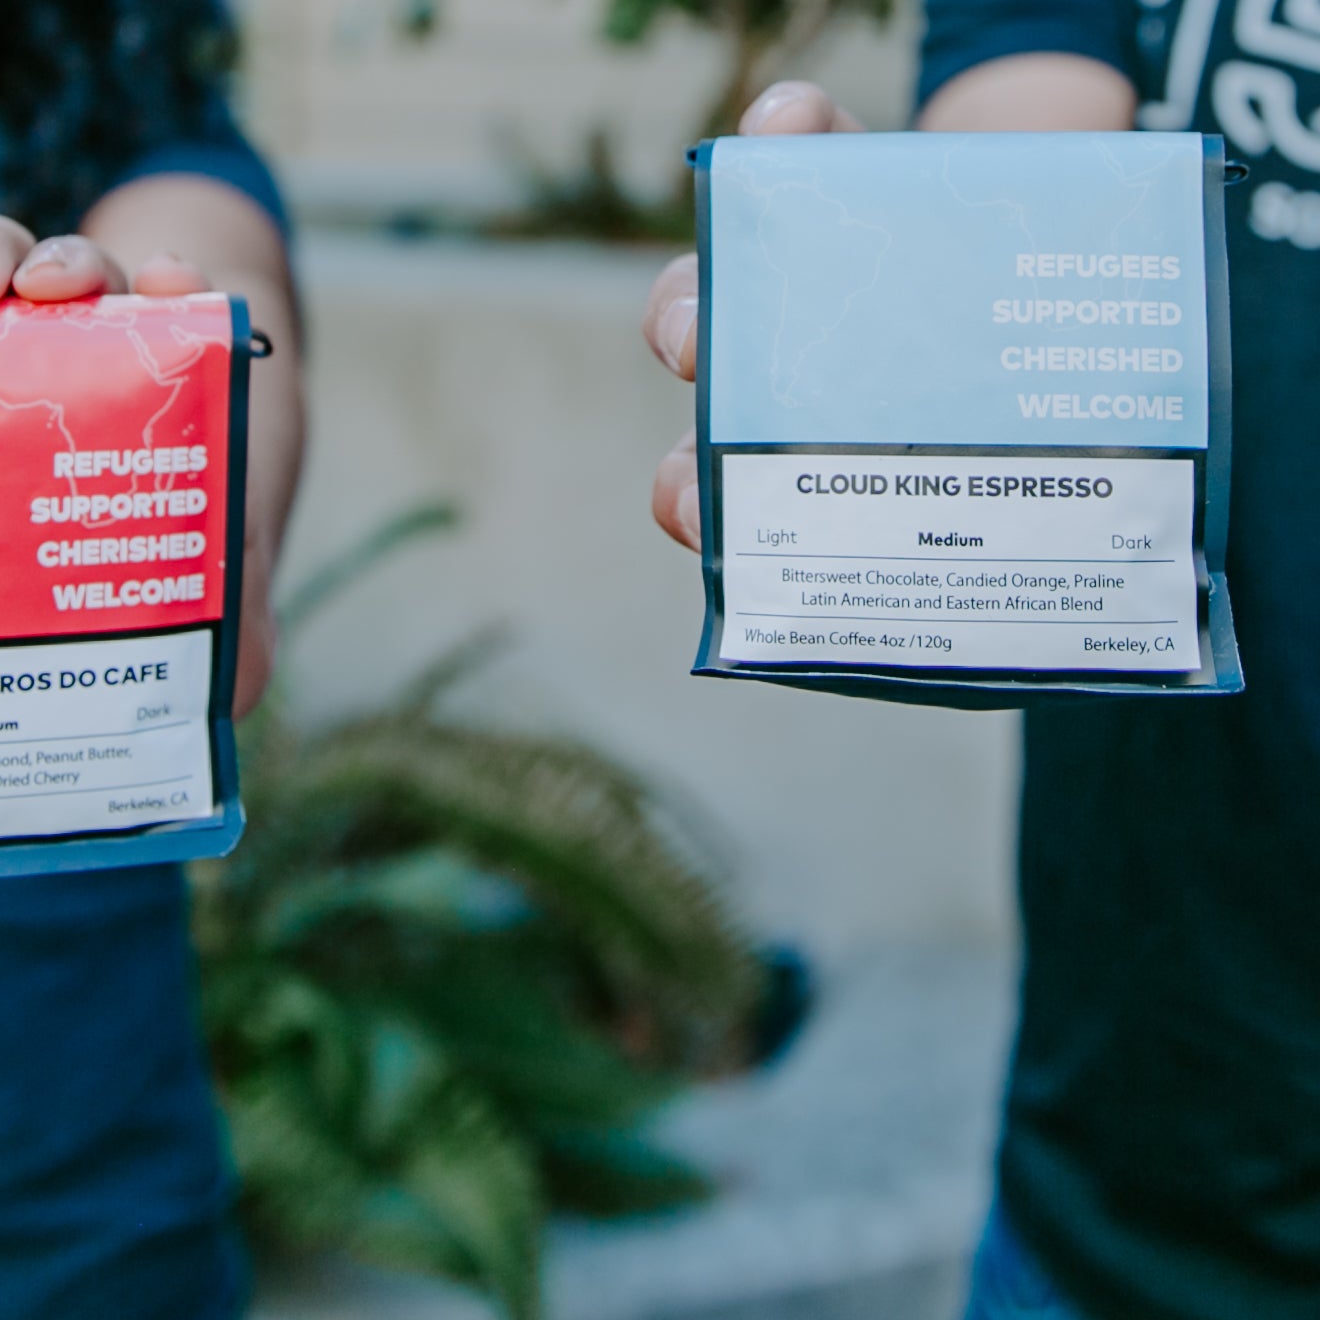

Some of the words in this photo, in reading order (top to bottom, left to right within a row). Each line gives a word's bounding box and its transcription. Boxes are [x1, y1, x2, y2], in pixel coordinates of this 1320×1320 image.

[1016, 253, 1181, 281] REFUGEES
[992, 299, 1182, 327] SUPPORTED
[1000, 346, 1183, 374] CHERISHED
[1018, 393, 1183, 421] WELCOME
[53, 445, 208, 479] REFUGEES
[796, 473, 889, 495] CLOUD
[895, 475, 962, 496] KING
[968, 476, 1113, 498] ESPRESSO
[30, 488, 207, 525] SUPPORTED
[37, 531, 206, 568] CHERISHED
[757, 528, 798, 547] Light
[918, 531, 984, 547] Medium
[1111, 534, 1152, 550] Dark
[782, 567, 861, 585] Bittersweet
[865, 570, 943, 588] Chocolate,
[946, 572, 1007, 588] Candied
[1011, 573, 1070, 591] Orange,
[1074, 574, 1125, 589] Praline
[52, 574, 205, 612] WELCOME
[801, 591, 837, 607] Latin
[841, 592, 910, 609] American
[914, 595, 942, 610] and
[946, 595, 1001, 610] Eastern
[1005, 596, 1057, 611] African
[1061, 596, 1104, 611] Blend
[744, 628, 786, 644] Whole
[789, 631, 825, 645] Bean
[829, 631, 876, 647] Coffee
[879, 633, 906, 648] 4oz
[908, 634, 953, 652] /120g
[1084, 636, 1151, 655] Berkeley,
[1154, 636, 1176, 651] CA
[60, 669, 96, 689] DO
[104, 662, 169, 685] CAFE
[136, 704, 171, 721] Dark
[36, 750, 84, 764] Peanut
[88, 747, 133, 761] Butter,
[33, 770, 80, 785] Cherry
[108, 797, 167, 813] Berkeley,
[170, 790, 189, 804] CA
